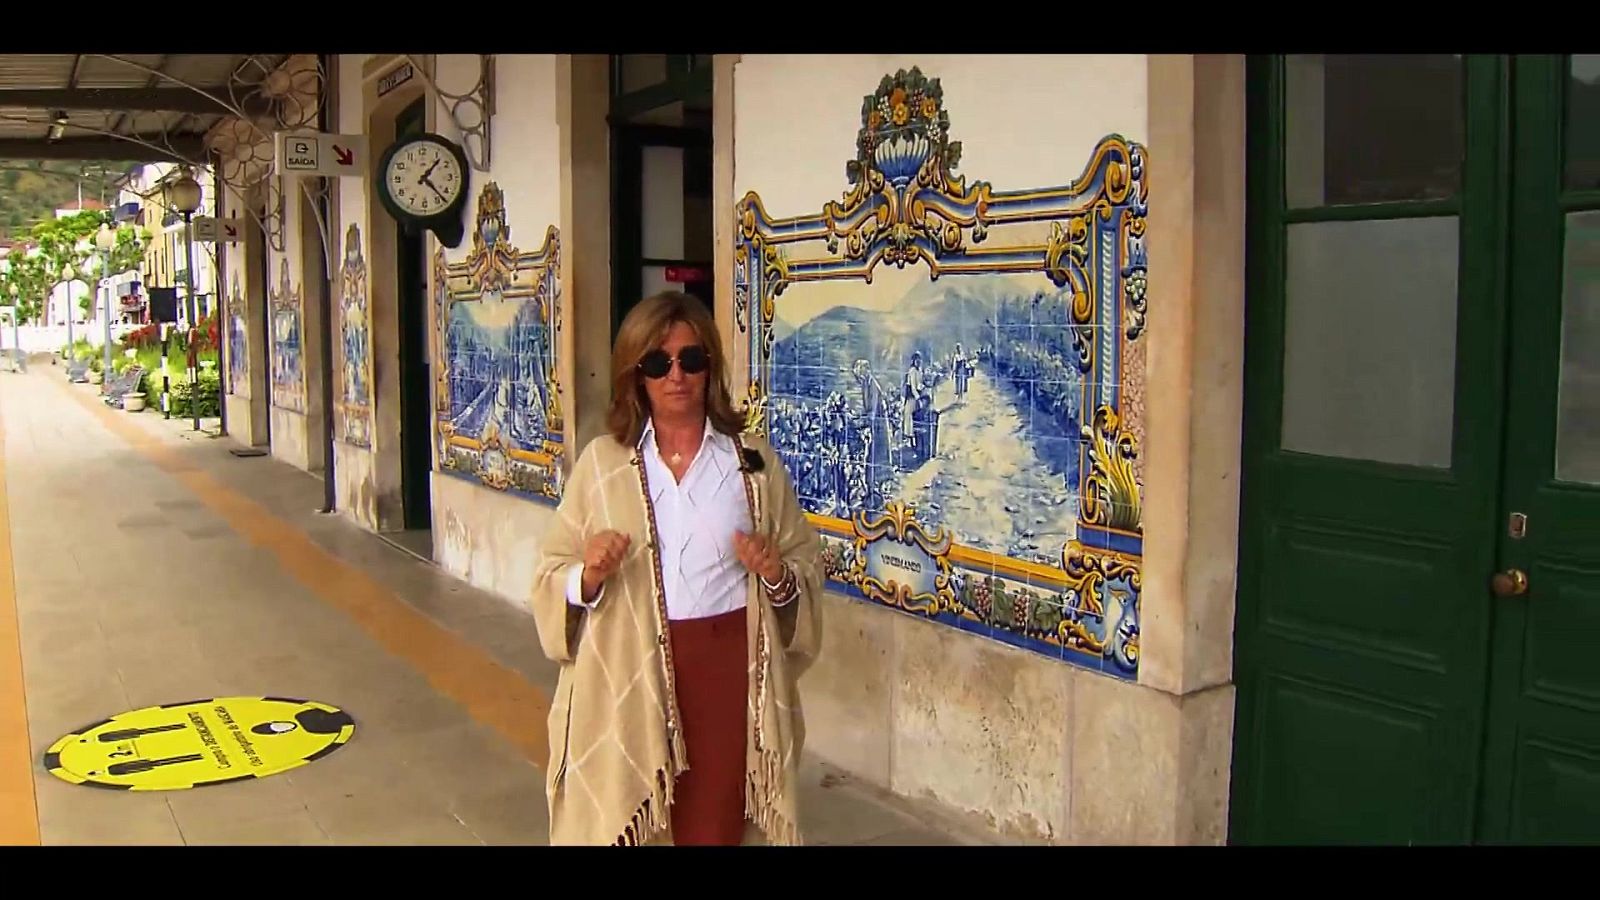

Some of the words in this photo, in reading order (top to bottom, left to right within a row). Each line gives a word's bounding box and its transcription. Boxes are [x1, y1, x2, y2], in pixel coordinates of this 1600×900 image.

[418, 147, 427, 156] 12
[406, 152, 414, 161] 11
[395, 162, 405, 171] 10
[443, 160, 450, 168] 2
[394, 175, 401, 184] 9
[447, 173, 453, 182] 3
[398, 188, 405, 197] 8
[443, 186, 449, 194] 4
[408, 197, 415, 206] 7
[421, 200, 428, 209] 6
